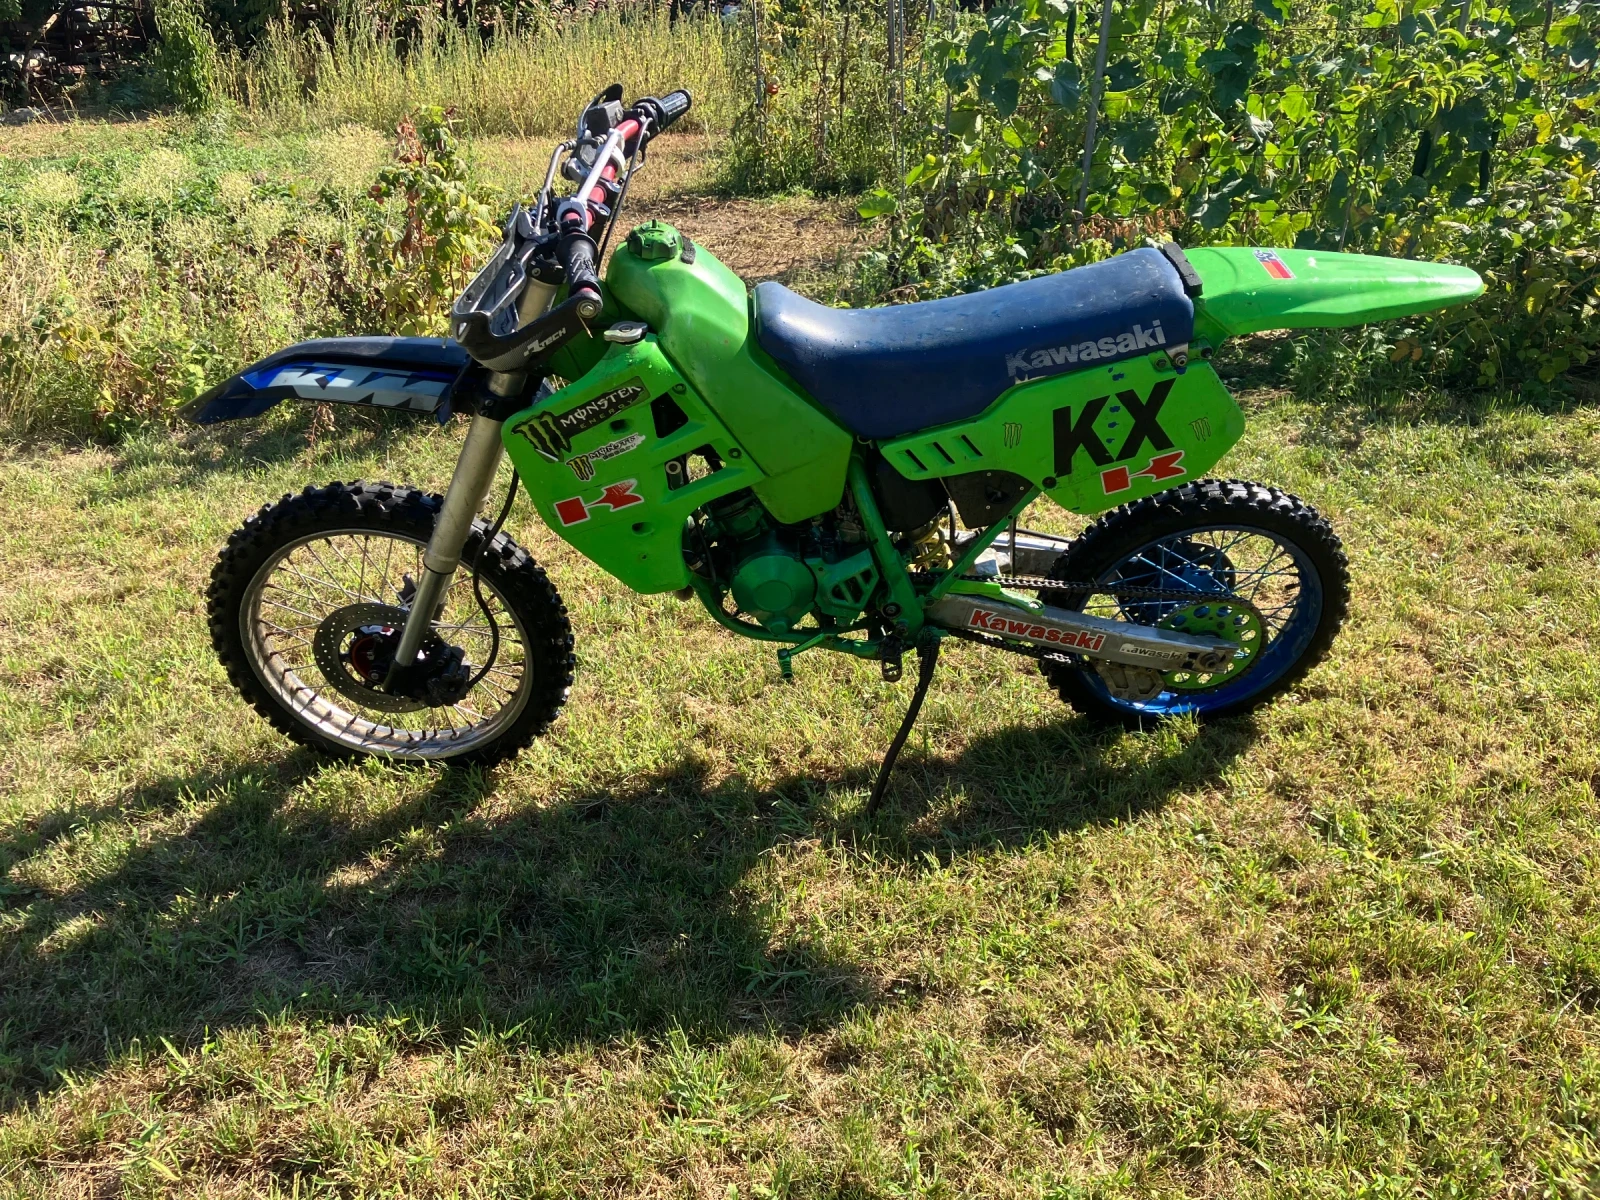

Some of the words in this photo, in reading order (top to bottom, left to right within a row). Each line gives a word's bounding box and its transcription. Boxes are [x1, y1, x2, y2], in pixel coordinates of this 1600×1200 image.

[1005, 320, 1166, 377] Kawasaki
[1053, 378, 1176, 478] KX
[969, 609, 1106, 651] Kawasaki
[1120, 645, 1183, 660] awasaki
